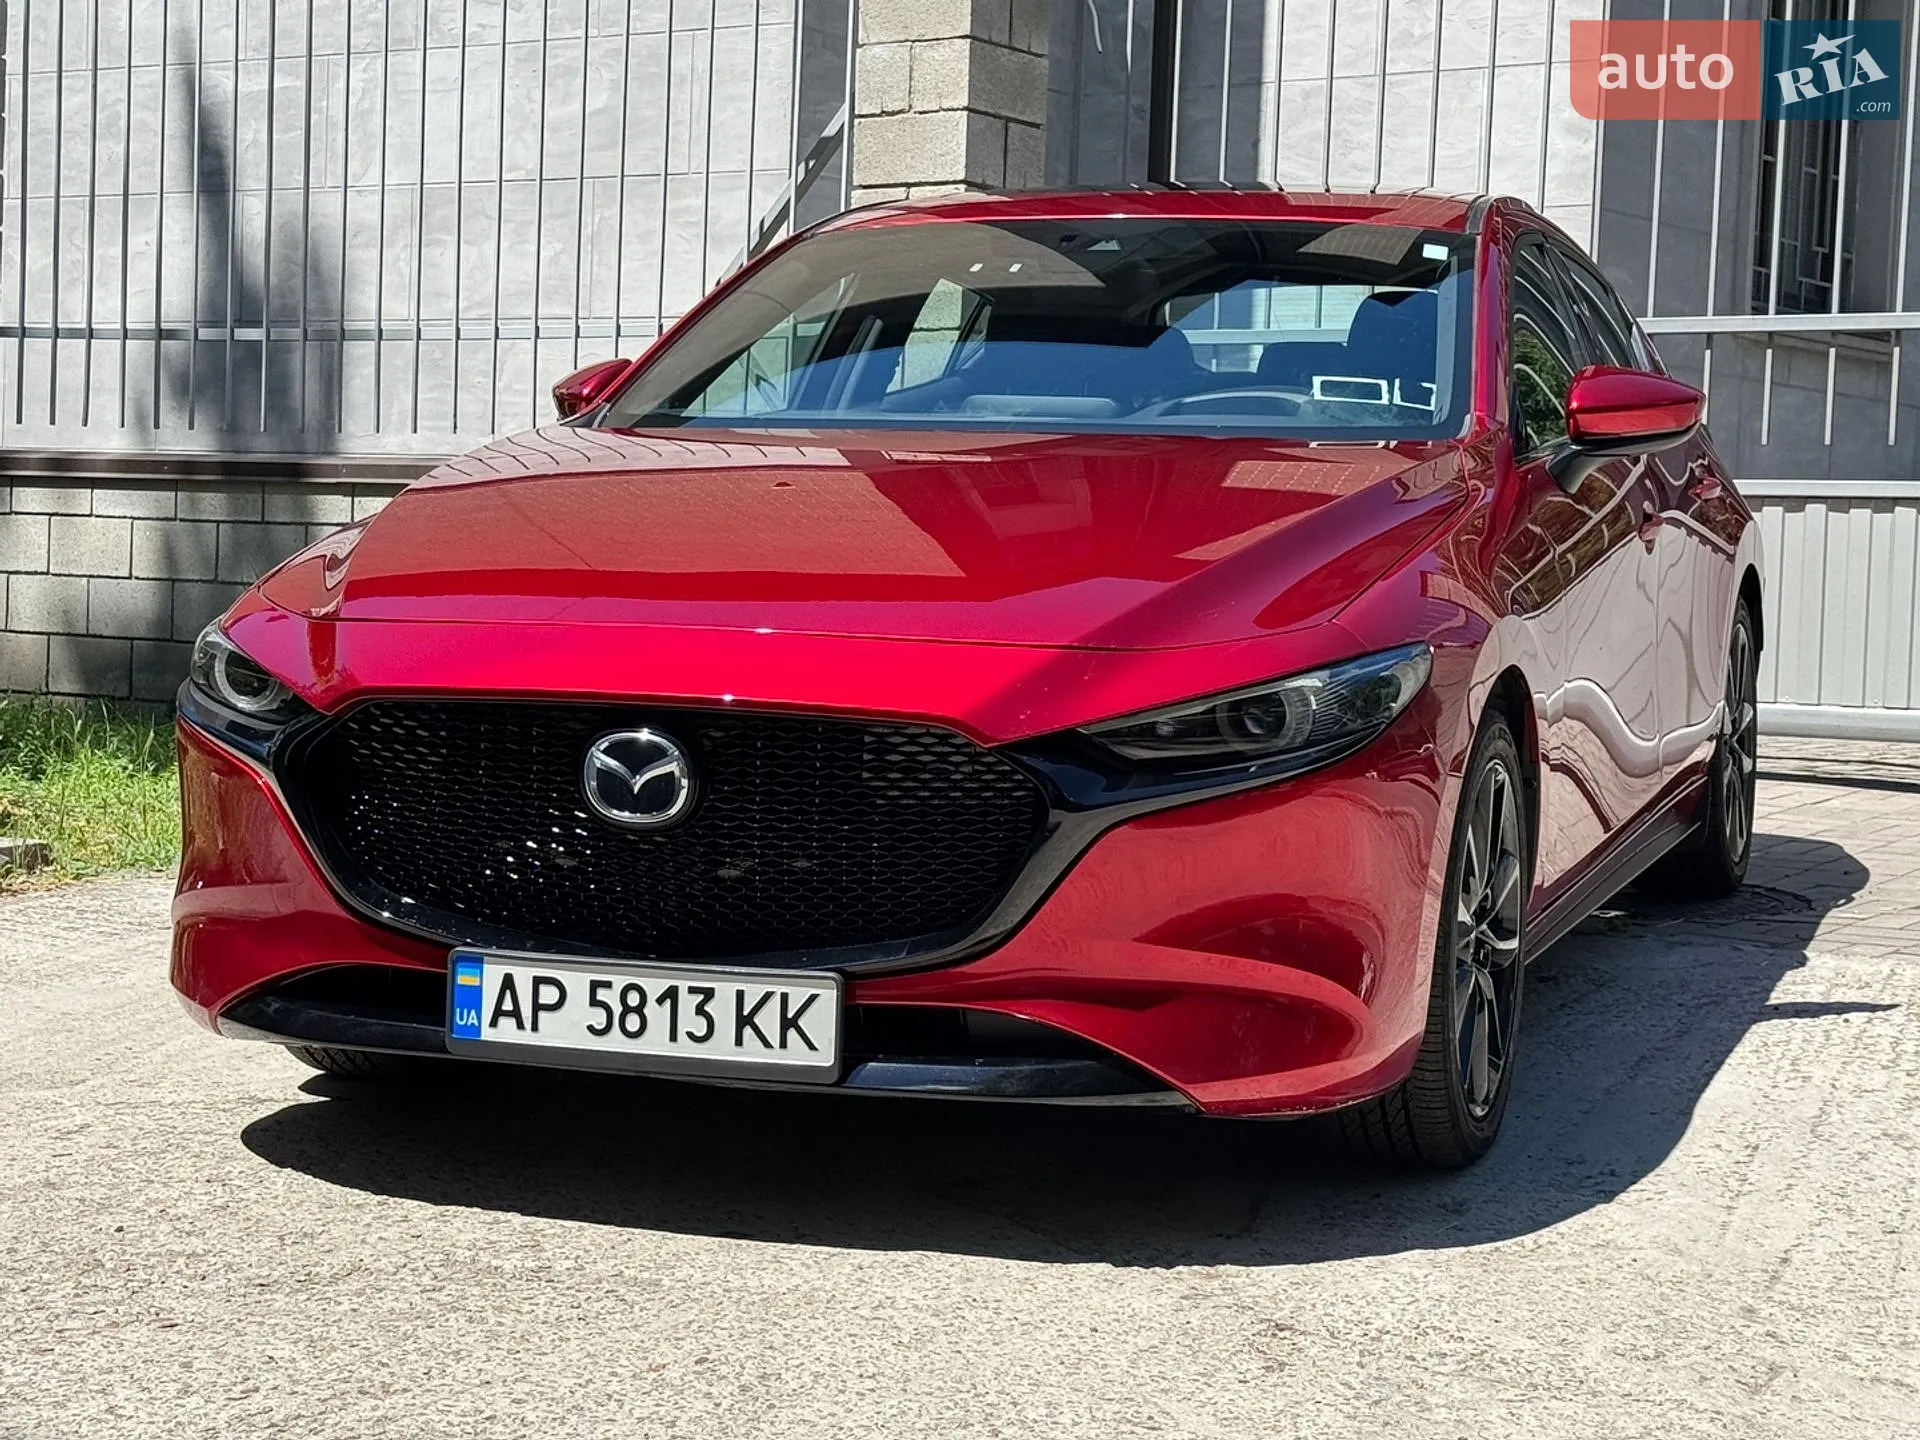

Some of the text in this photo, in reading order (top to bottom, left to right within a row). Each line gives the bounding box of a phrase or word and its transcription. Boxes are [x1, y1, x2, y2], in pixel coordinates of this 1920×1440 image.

[456, 1007, 479, 1027] UA
[488, 972, 821, 1052] AP 5813 KK
